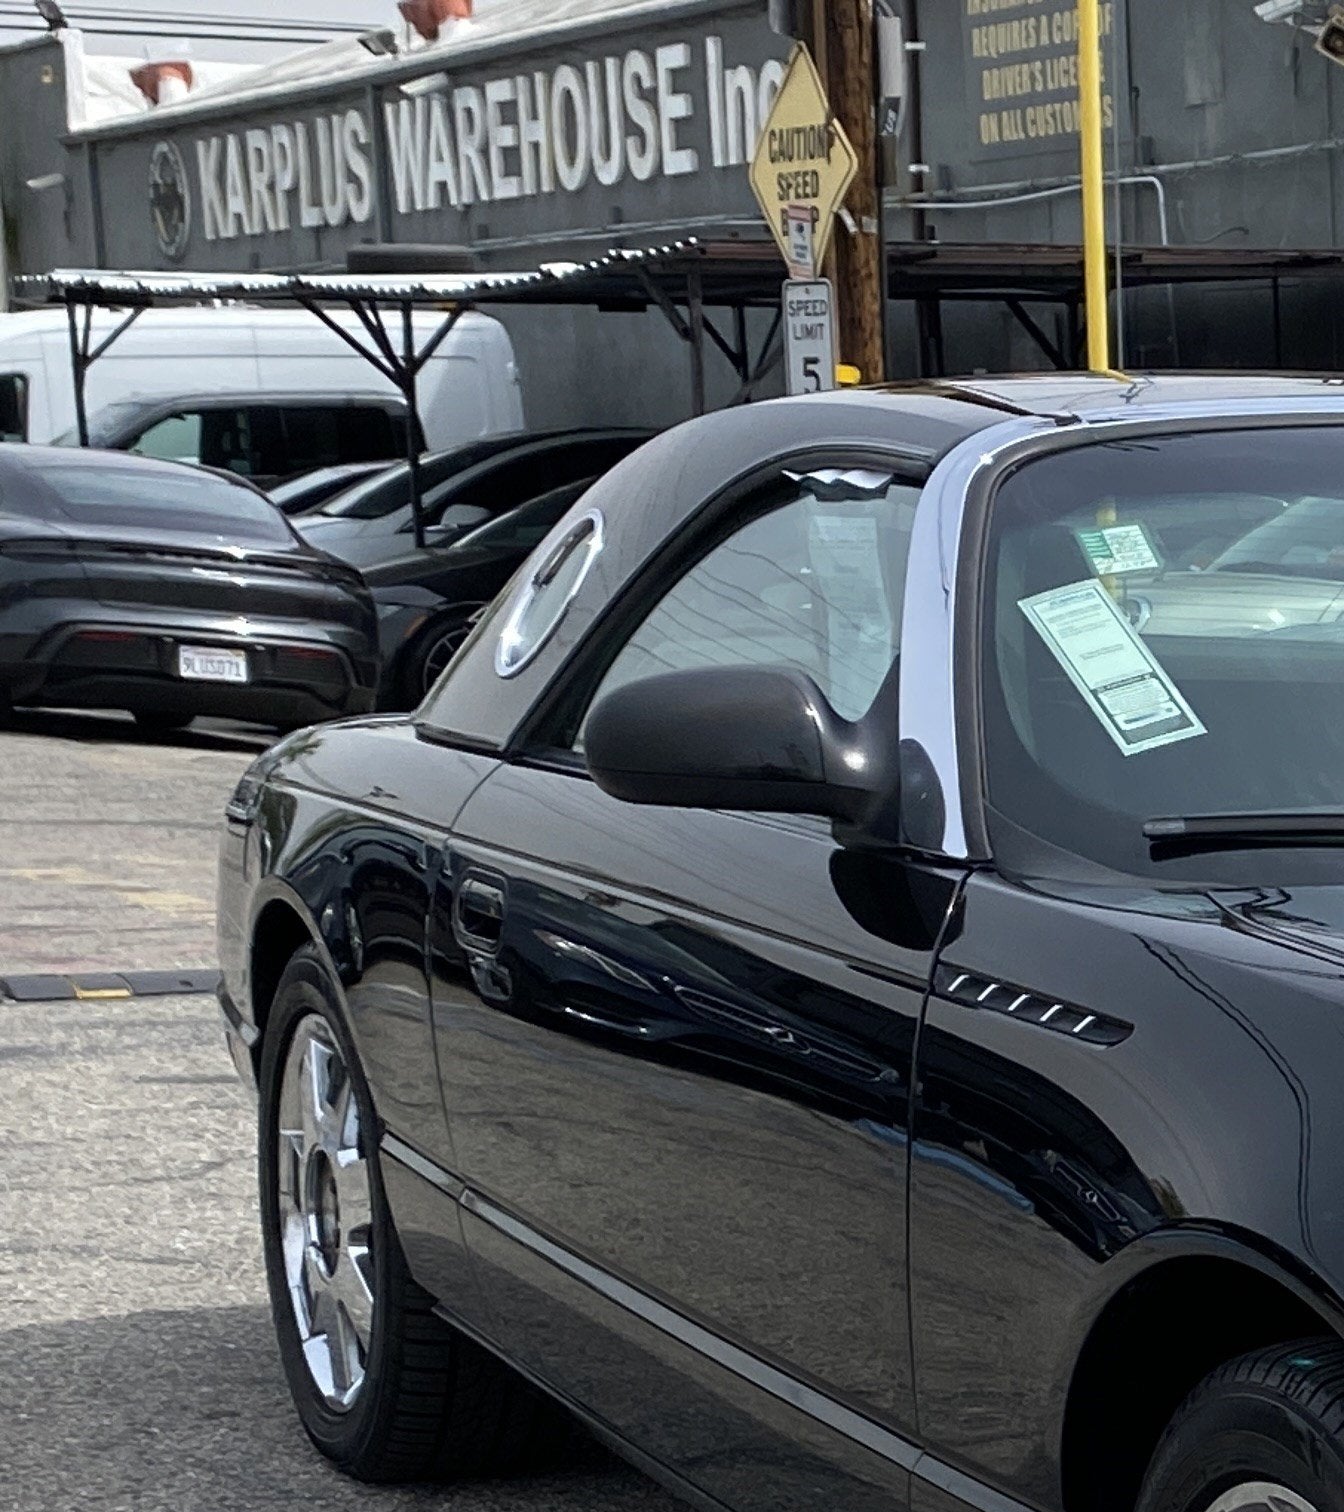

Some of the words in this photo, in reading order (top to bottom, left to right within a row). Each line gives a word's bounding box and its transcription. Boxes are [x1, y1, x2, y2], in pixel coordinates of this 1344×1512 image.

[972, 17, 1036, 58] REQUIRES
[1040, 14, 1049, 46] A
[982, 60, 1044, 100] DRIVER'S
[196, 108, 371, 240] KARPLUS
[384, 42, 698, 214] WAREHOUSE
[769, 124, 830, 164] CAUTION
[980, 112, 1000, 144] ON
[1002, 109, 1025, 141] ALL
[777, 169, 820, 201] SPEED
[788, 299, 827, 317] SPEED
[793, 323, 825, 340] LIMIT
[803, 356, 821, 393] 5
